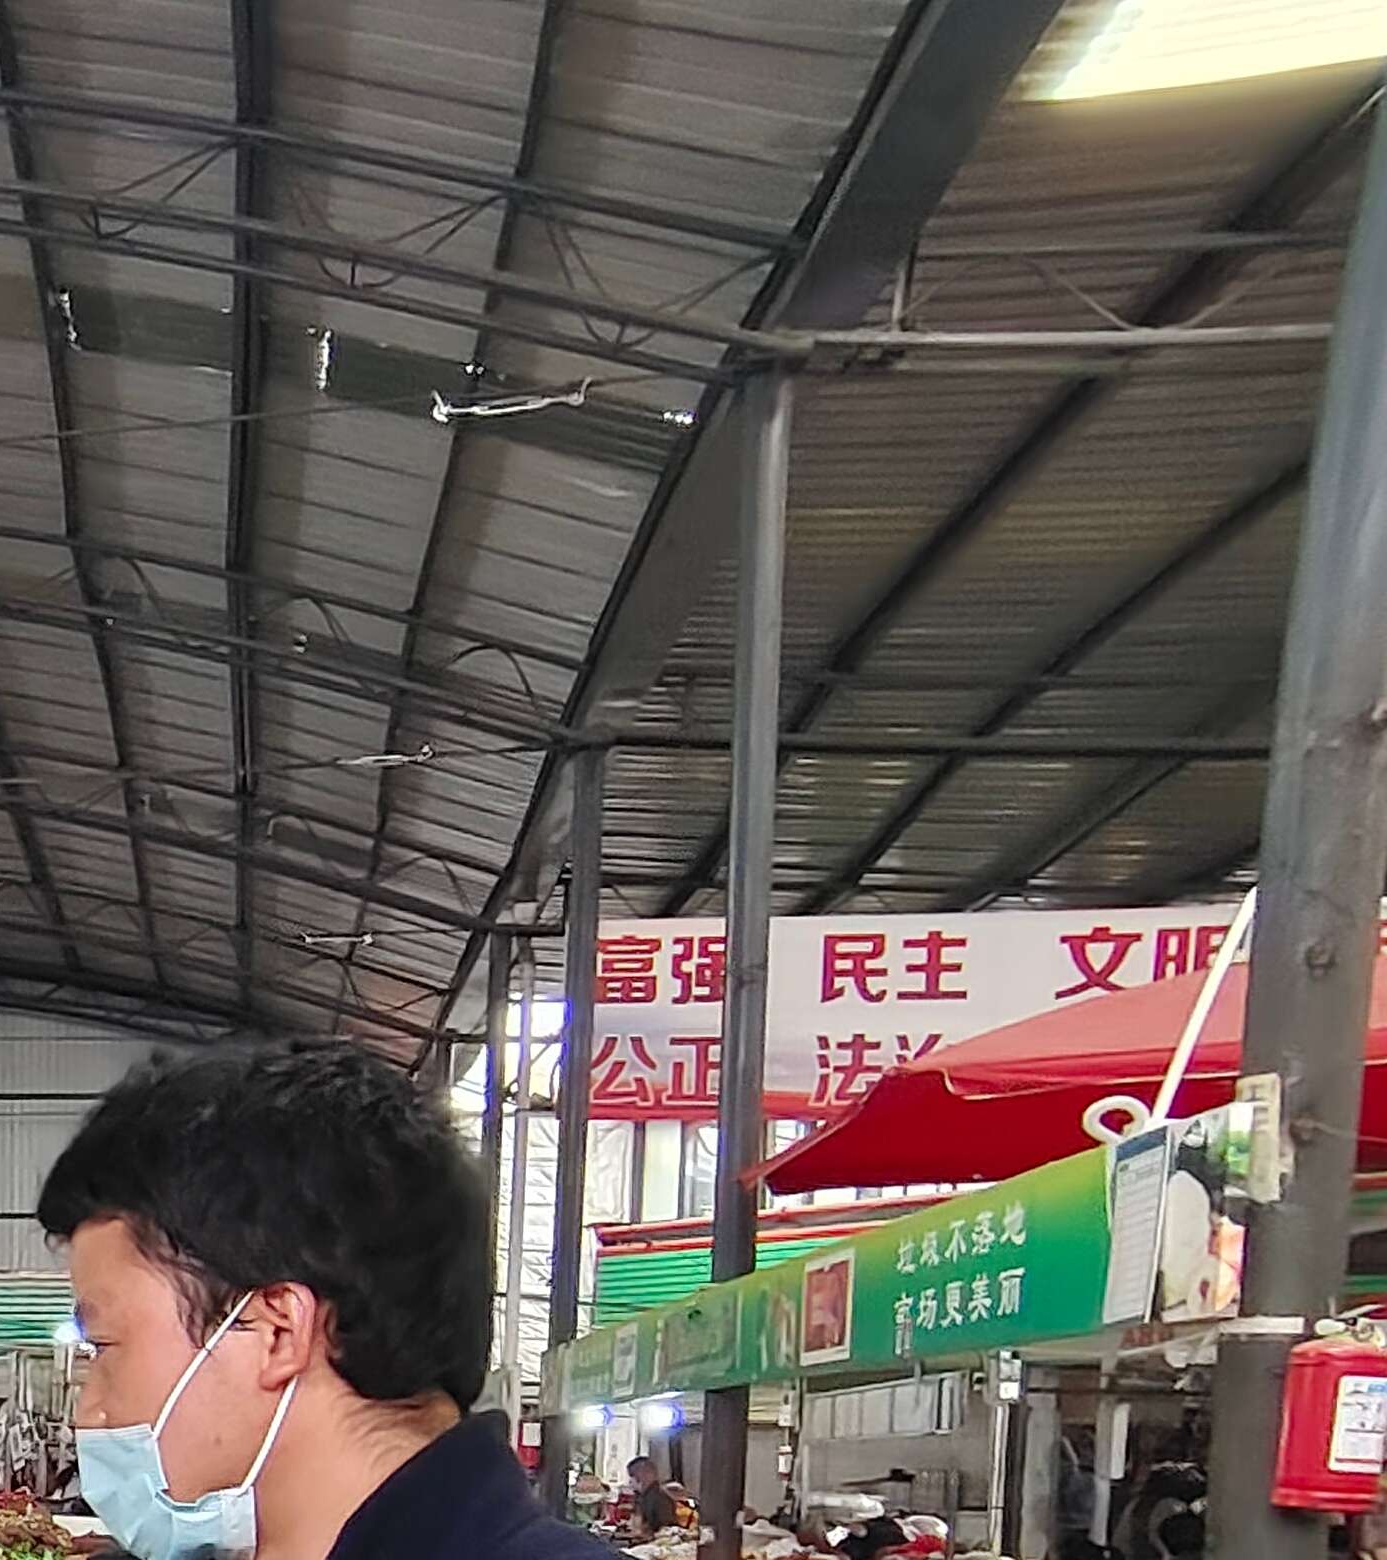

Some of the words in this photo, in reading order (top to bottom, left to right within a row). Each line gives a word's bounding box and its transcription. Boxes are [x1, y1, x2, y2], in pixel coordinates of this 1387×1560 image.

[596, 935, 726, 1004] 富强
[820, 930, 968, 1003] 民主
[591, 1034, 721, 1105] 公正
[895, 1200, 1027, 1275] 垃圾不落地
